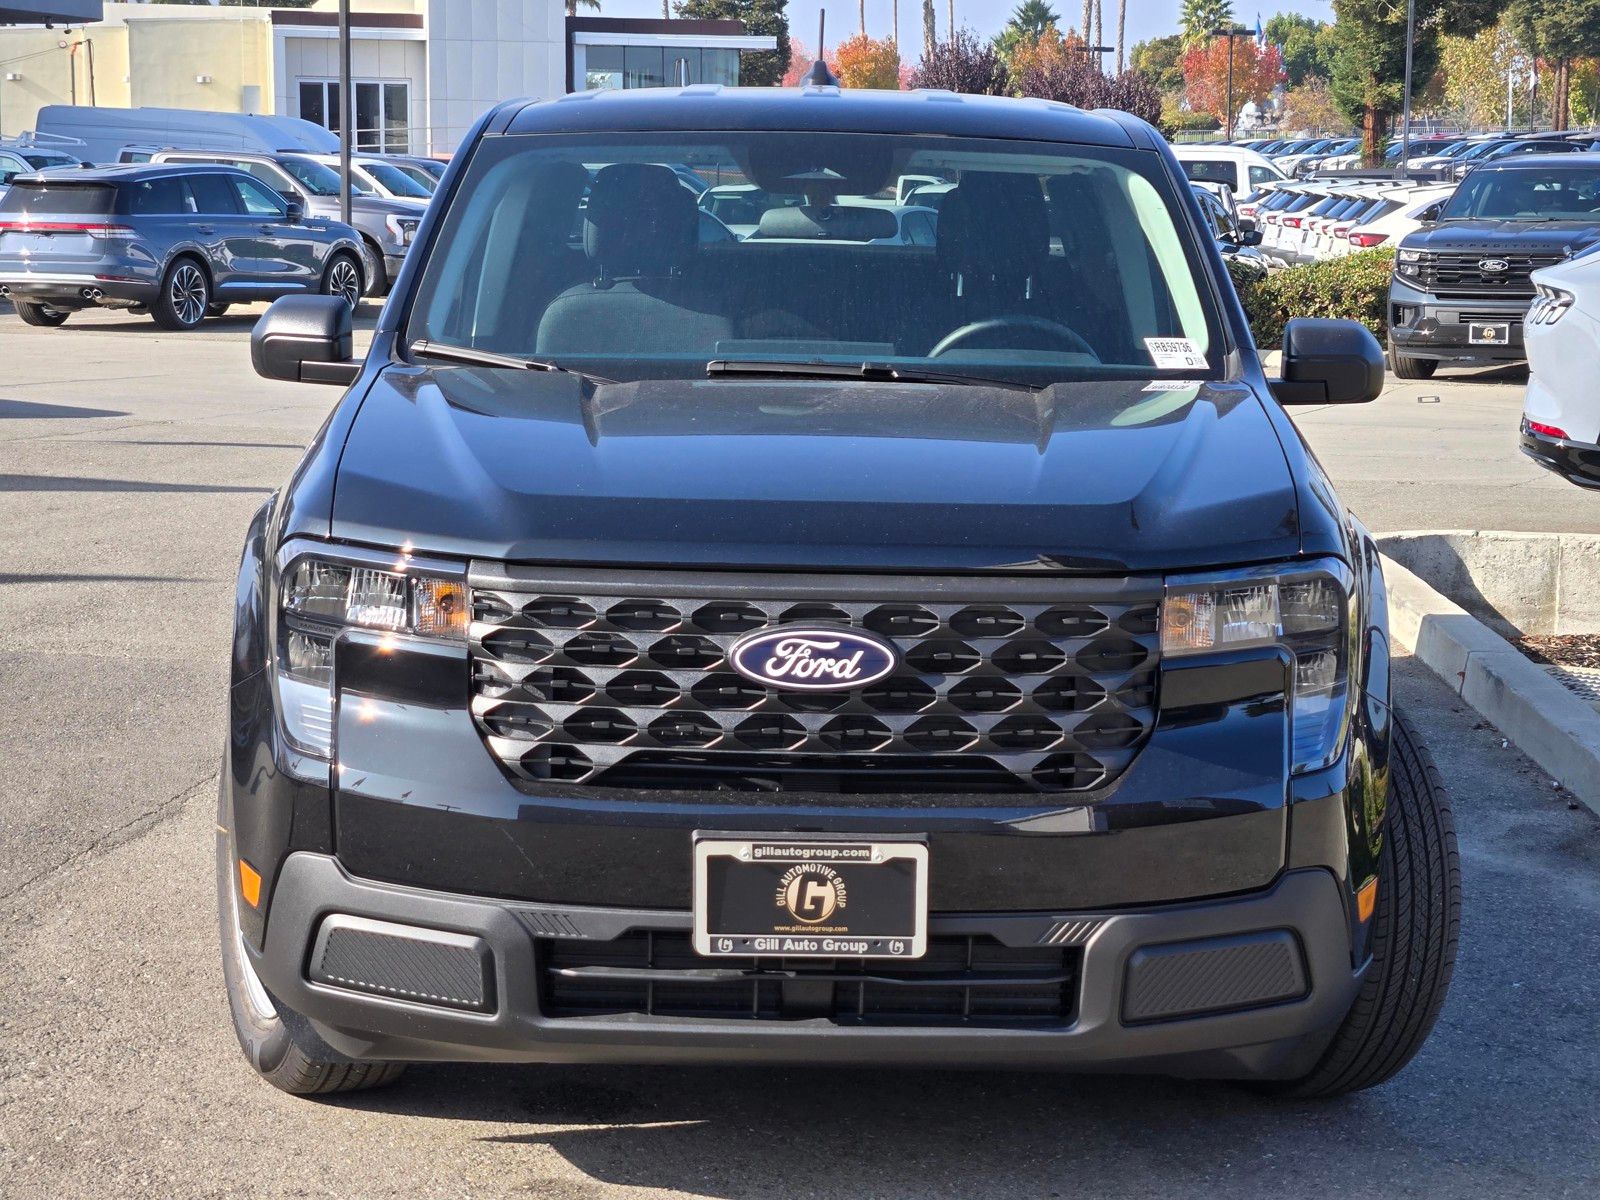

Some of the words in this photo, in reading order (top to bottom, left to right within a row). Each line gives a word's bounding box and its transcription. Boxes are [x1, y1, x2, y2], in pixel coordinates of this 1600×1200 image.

[1484, 260, 1503, 270] Ford
[765, 638, 865, 679] Ford
[754, 846, 870, 859] gillautogroup.com
[780, 863, 837, 886] AUTOMOTIVE
[776, 886, 787, 907] GILL
[832, 877, 847, 908] GROUP
[774, 924, 849, 933] www.gillautogroup.com
[754, 938, 780, 951] Gill
[783, 938, 818, 951] Auto
[822, 939, 868, 954] Group
